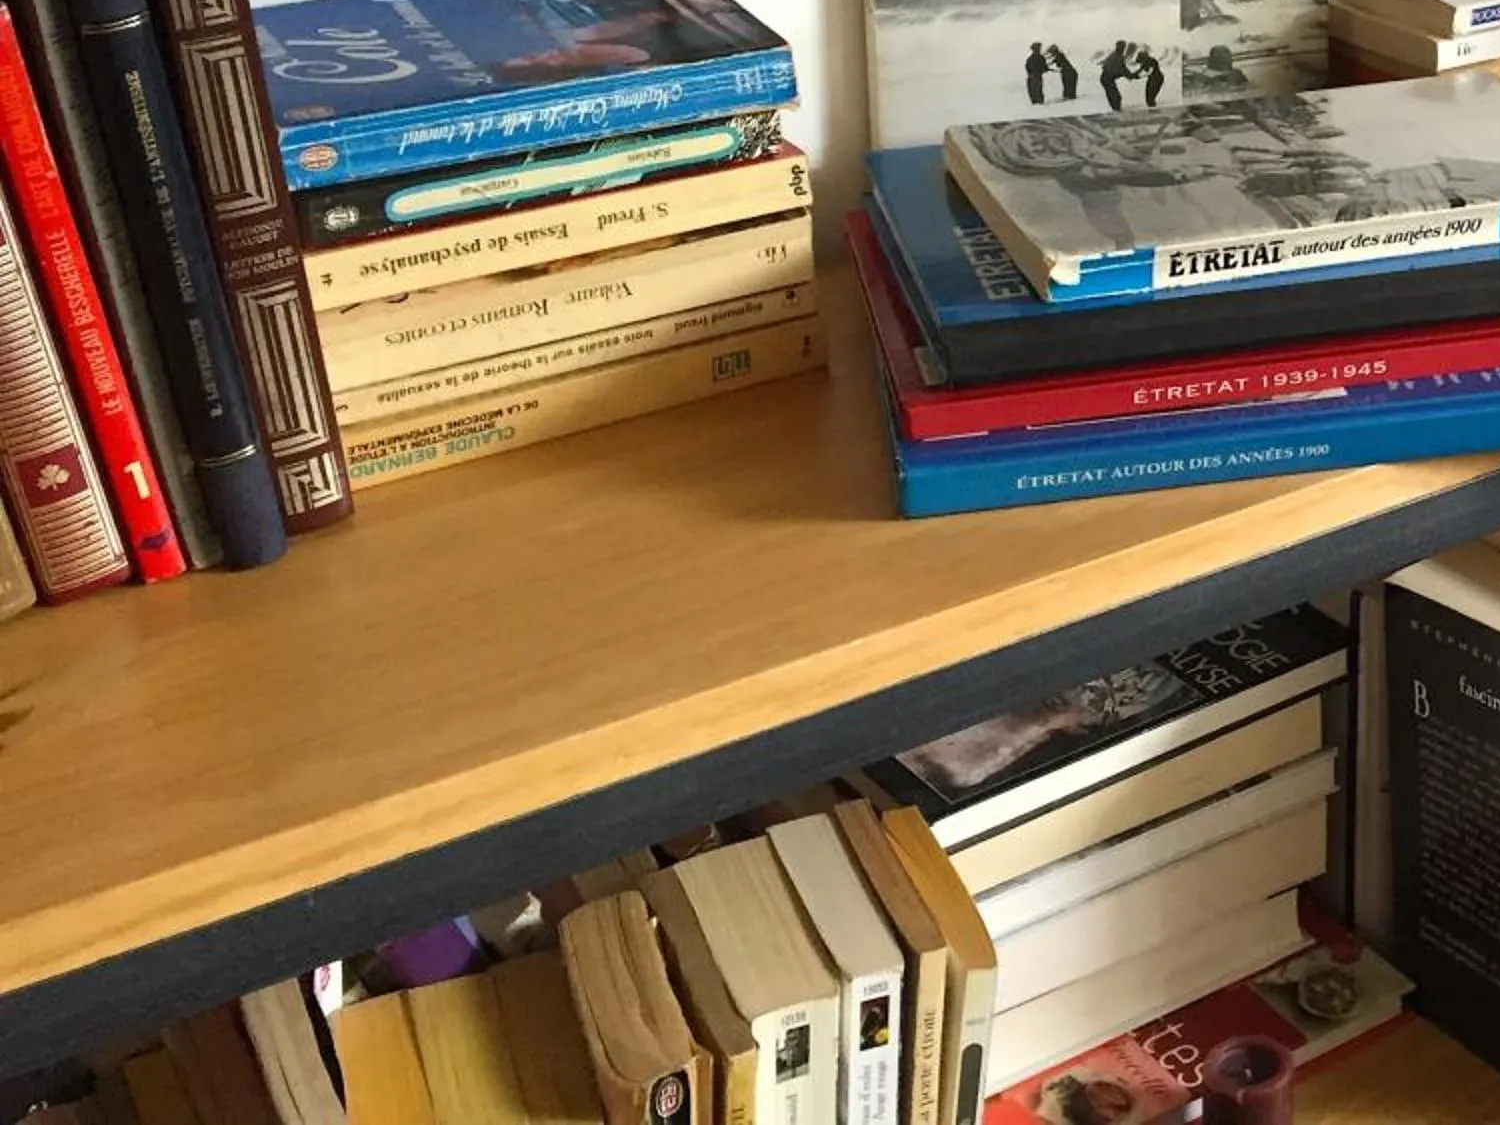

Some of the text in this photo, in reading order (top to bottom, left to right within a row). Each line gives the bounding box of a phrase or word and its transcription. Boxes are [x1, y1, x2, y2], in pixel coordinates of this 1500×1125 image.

[272, 27, 418, 84] Cole
[359, 201, 670, 277] S. Freud Essais de psychanalyse
[1168, 216, 1481, 278] ÉTRETAT autour des années 1900
[46, 228, 92, 326] BESCHERELLE
[450, 316, 468, 333] et
[474, 298, 549, 326] Romans
[673, 316, 708, 333] freud
[384, 323, 448, 347] contes
[577, 335, 620, 356] essais
[623, 329, 654, 347] trois
[78, 325, 114, 395] NOUVEAU
[552, 346, 574, 364] sur
[445, 371, 459, 387] la
[462, 366, 481, 384] de
[1133, 376, 1248, 404] ÉTRETAT
[1262, 360, 1387, 388] 1939-1945
[102, 398, 122, 418] LE
[523, 399, 539, 412] DE
[350, 426, 516, 477] CLAUDE BERNARD
[1110, 458, 1185, 480] AUTOUR
[1189, 452, 1223, 472] DES
[1226, 443, 1293, 466] ANNÉES
[1298, 441, 1329, 460] 1900
[124, 461, 150, 499] 1
